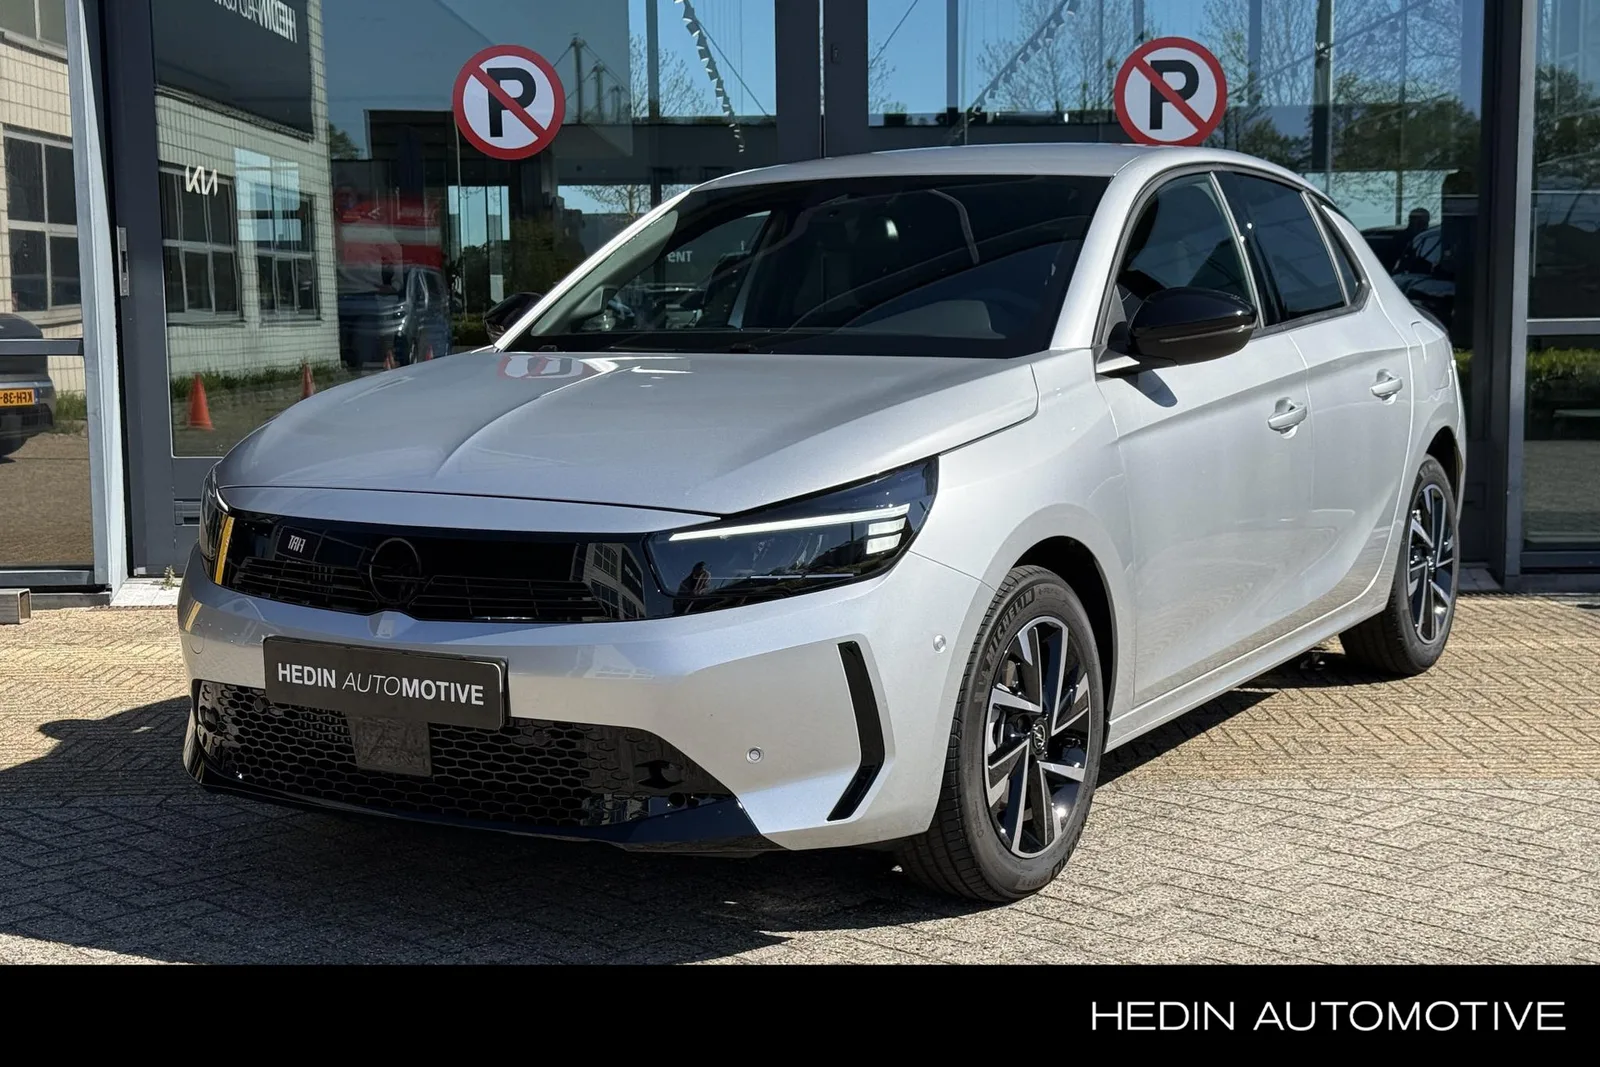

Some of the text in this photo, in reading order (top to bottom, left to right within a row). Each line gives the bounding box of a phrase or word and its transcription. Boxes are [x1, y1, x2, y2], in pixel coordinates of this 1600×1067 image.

[487, 67, 537, 138] P
[1149, 59, 1200, 130] P
[985, 587, 1035, 667] MICHELIN
[277, 662, 485, 706] HEDIN AUTOMOTIVE
